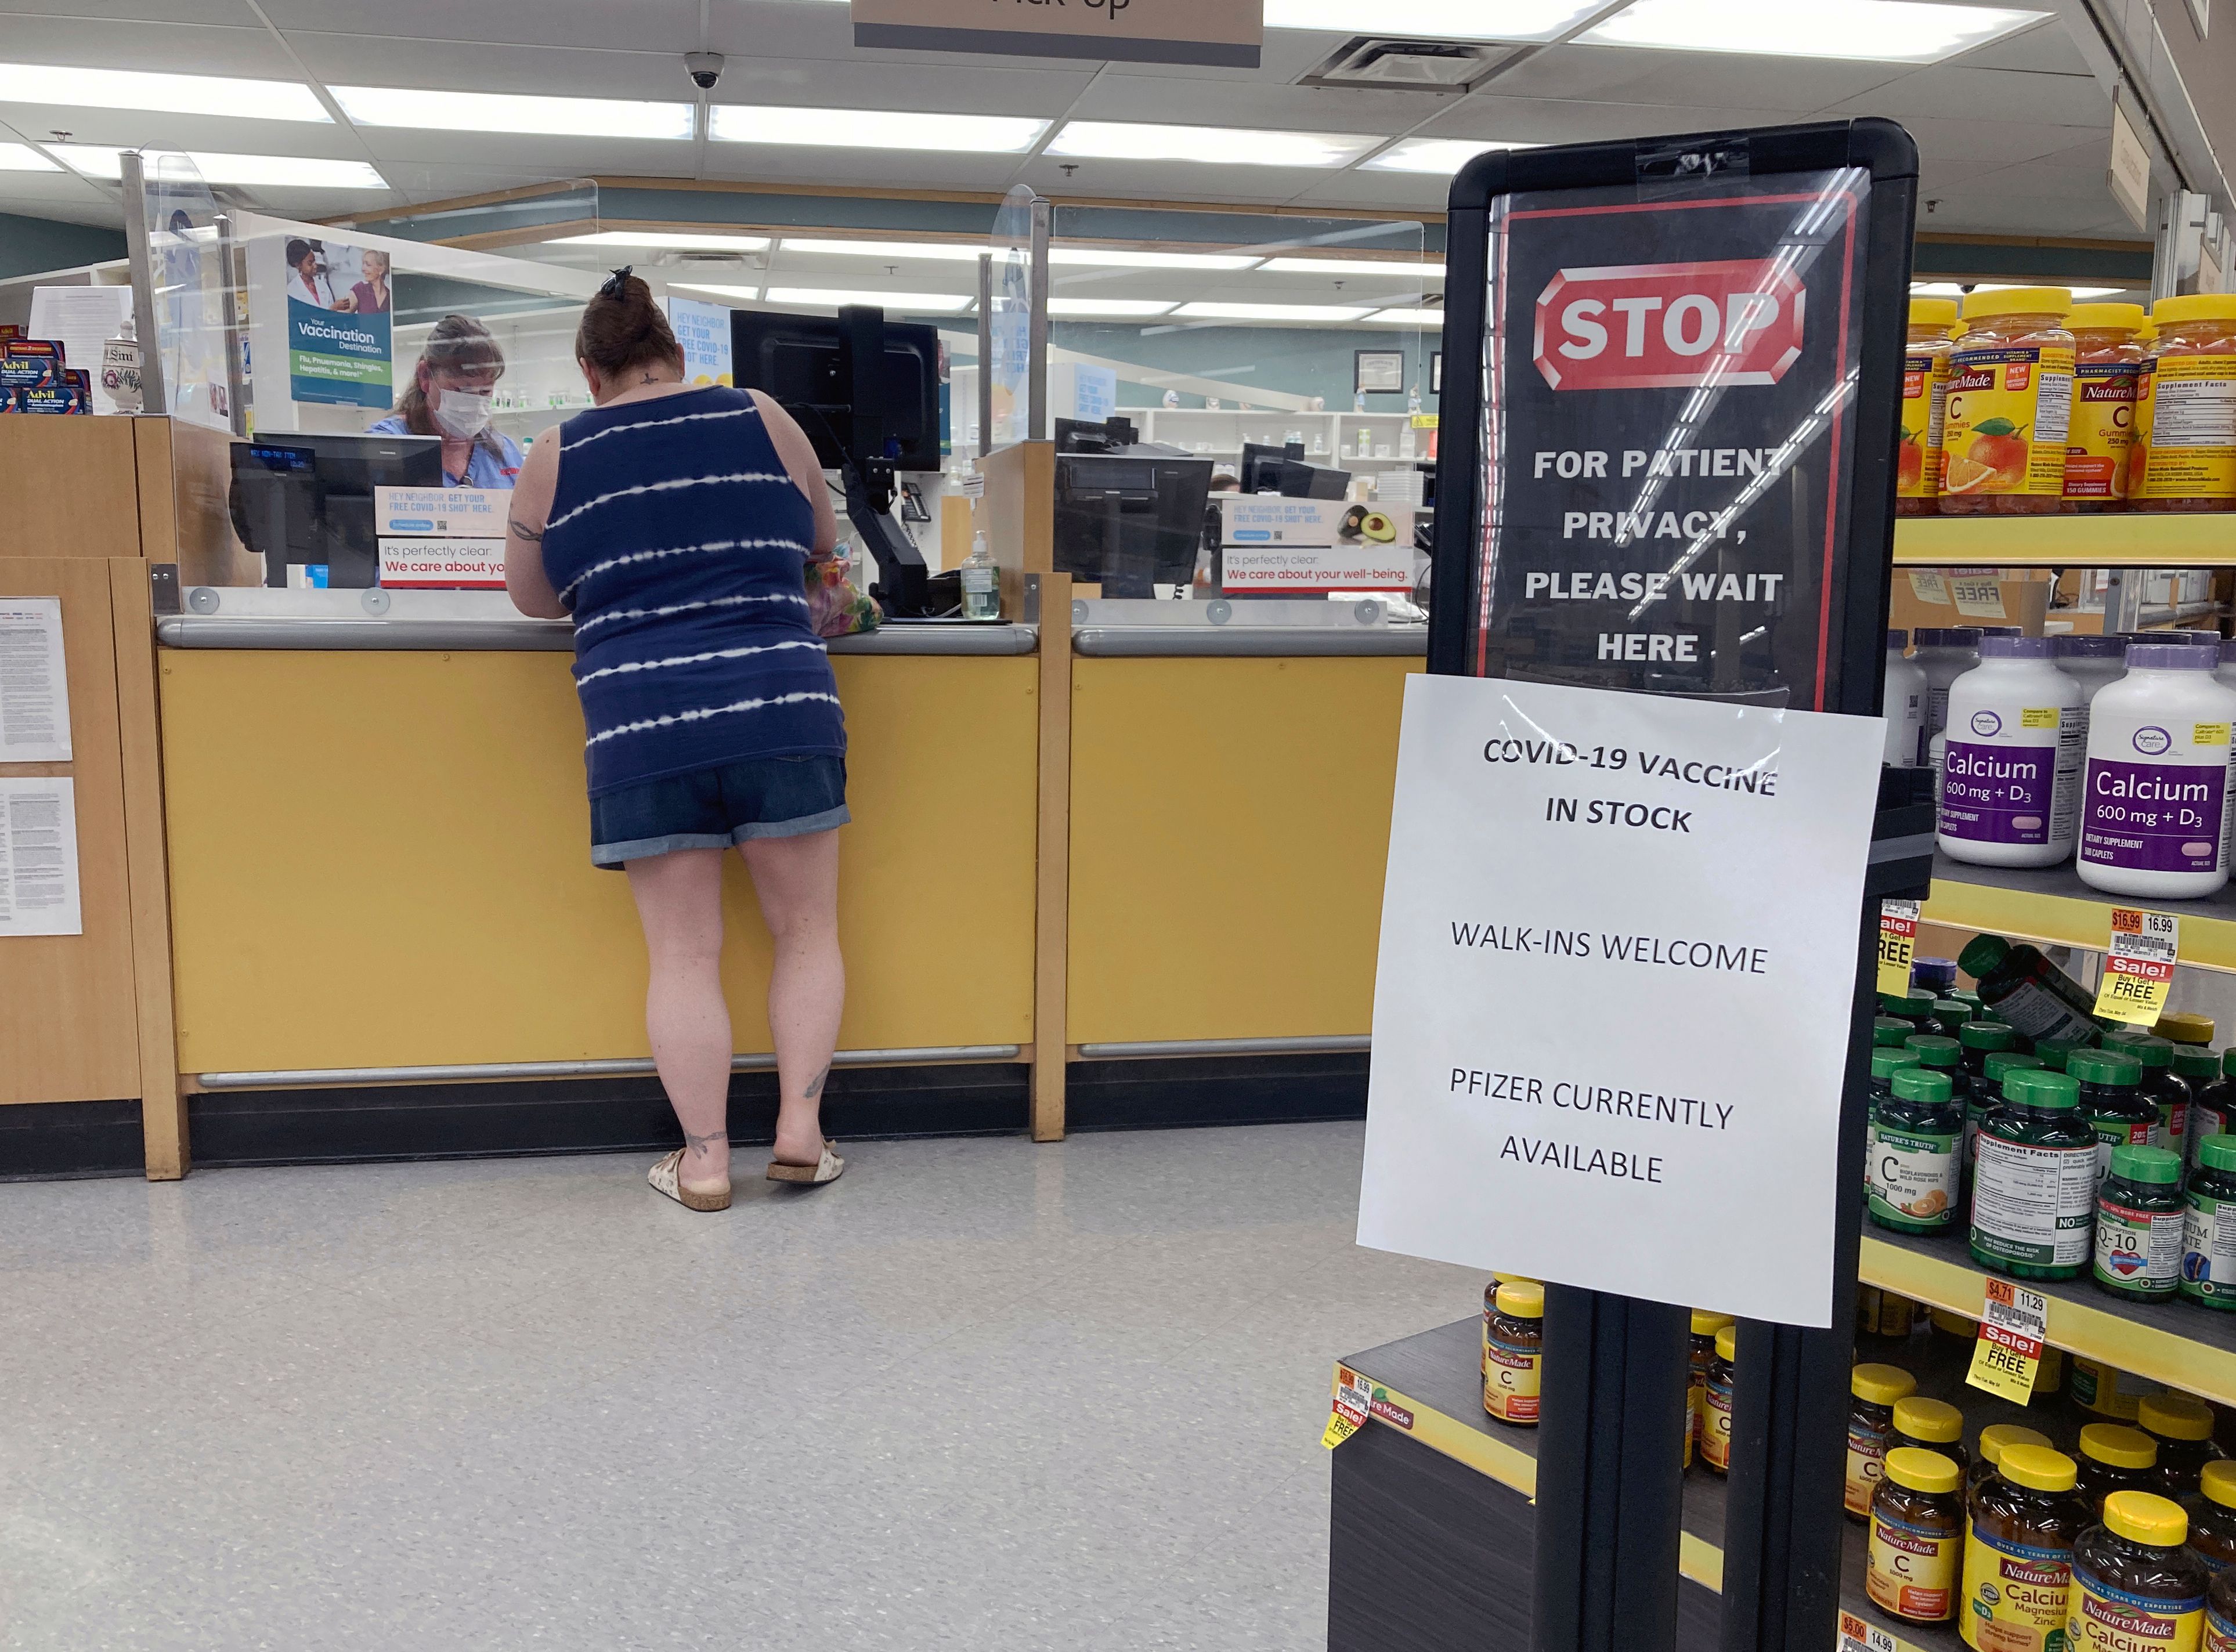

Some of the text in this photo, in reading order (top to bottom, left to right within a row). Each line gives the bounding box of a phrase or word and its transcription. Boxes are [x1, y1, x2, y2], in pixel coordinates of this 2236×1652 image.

[677, 312, 691, 324] HEY
[1558, 293, 1779, 359] STOP
[298, 322, 374, 344] Vaccination
[678, 325, 710, 339] GET YOUR
[339, 341, 382, 354] Destination
[697, 340, 728, 355] COVID-19
[1, 361, 29, 369] Advil
[299, 355, 312, 363] Flu,
[353, 362, 383, 373] Shingles,
[300, 364, 332, 375] Hepatitis,
[27, 390, 55, 398] Advil
[1950, 396, 1962, 419] C
[2112, 406, 2129, 428] C
[1534, 448, 1785, 478] FOR PATIENT
[389, 493, 403, 501] HEY
[389, 503, 408, 511] FREE
[411, 503, 446, 512] COVID-19
[1563, 511, 1746, 544] PRIVACY,
[385, 546, 399, 555] It's
[403, 546, 456, 558] perfectly
[1227, 556, 1239, 564] It's
[1242, 555, 1288, 566] perfectly
[385, 561, 485, 572] We care about
[1227, 570, 1246, 579] We
[1278, 569, 1312, 579] about
[1315, 571, 1341, 582] your
[1343, 569, 1408, 581] well-being.
[1525, 572, 1783, 601] PLEASE WAIT
[1598, 633, 1698, 661] HERE
[1483, 739, 1778, 796] COVID-19 VACCINE
[1947, 751, 2036, 779] Calcium
[1946, 782, 1966, 796] 600
[1969, 788, 1991, 801] mg
[1995, 789, 2004, 797] +
[2096, 771, 2208, 801] Calcium
[1546, 797, 1692, 833] IN STOCK
[1950, 811, 1979, 822] SUPPLEMENT
[2097, 805, 2126, 820] 600
[2130, 812, 2158, 826] mg
[2163, 812, 2173, 822] +
[2086, 833, 2143, 849] DIETARY SUPPLEMENT
[2092, 848, 2114, 859] CAPLETS
[1880, 919, 1910, 933] ale!
[2112, 912, 2172, 932] $16.99 16.99
[1451, 921, 1768, 974] WALK-INS WELCOME
[1879, 939, 1910, 964] REE
[2112, 959, 2166, 977] Sale!
[2118, 974, 2150, 985] Buy Get
[2114, 981, 2155, 999] FREE
[1450, 1068, 1734, 1130] PFIZER CURRENTLY
[1880, 1133, 1908, 1145] NATURE'S
[1980, 1135, 2027, 1155] Supplement
[1500, 1135, 1663, 1183] AVAILABLE
[1881, 1156, 1899, 1182] C
[1899, 1169, 1939, 1177] BIOFLAVONOIDS
[1886, 1183, 1902, 1192] 1000
[2059, 1219, 2075, 1227] NO
[1993, 1239, 2014, 1249] REDUCE
[2026, 1245, 2039, 1253] RISK
[1989, 1281, 2043, 1311] $4.71 11.29
[1986, 1326, 2035, 1354] Sale!
[1992, 1343, 2022, 1360] Buy Get
[1988, 1350, 2026, 1375] FREE
[1357, 1379, 1370, 1393] 16.99
[1501, 1371, 1512, 1384] C
[1336, 1403, 1363, 1425] Sale!
[1383, 1404, 1409, 1425] Made
[1864, 1462, 1877, 1477] C
[1996, 1542, 2014, 1550] OVER
[1894, 1555, 1909, 1572] C
[1890, 1569, 1903, 1578] 1000
[1982, 1588, 1998, 1600] USP
[2082, 1577, 2095, 1588] OVER
[2107, 1591, 2128, 1603] YEARS
[2033, 1617, 2056, 1626] Zinc
[1985, 1622, 2032, 1640] Helps support
[1985, 1629, 2006, 1642] strong
[2086, 1621, 2166, 1652] Calcium
[1872, 1633, 1892, 1652] 14.99
